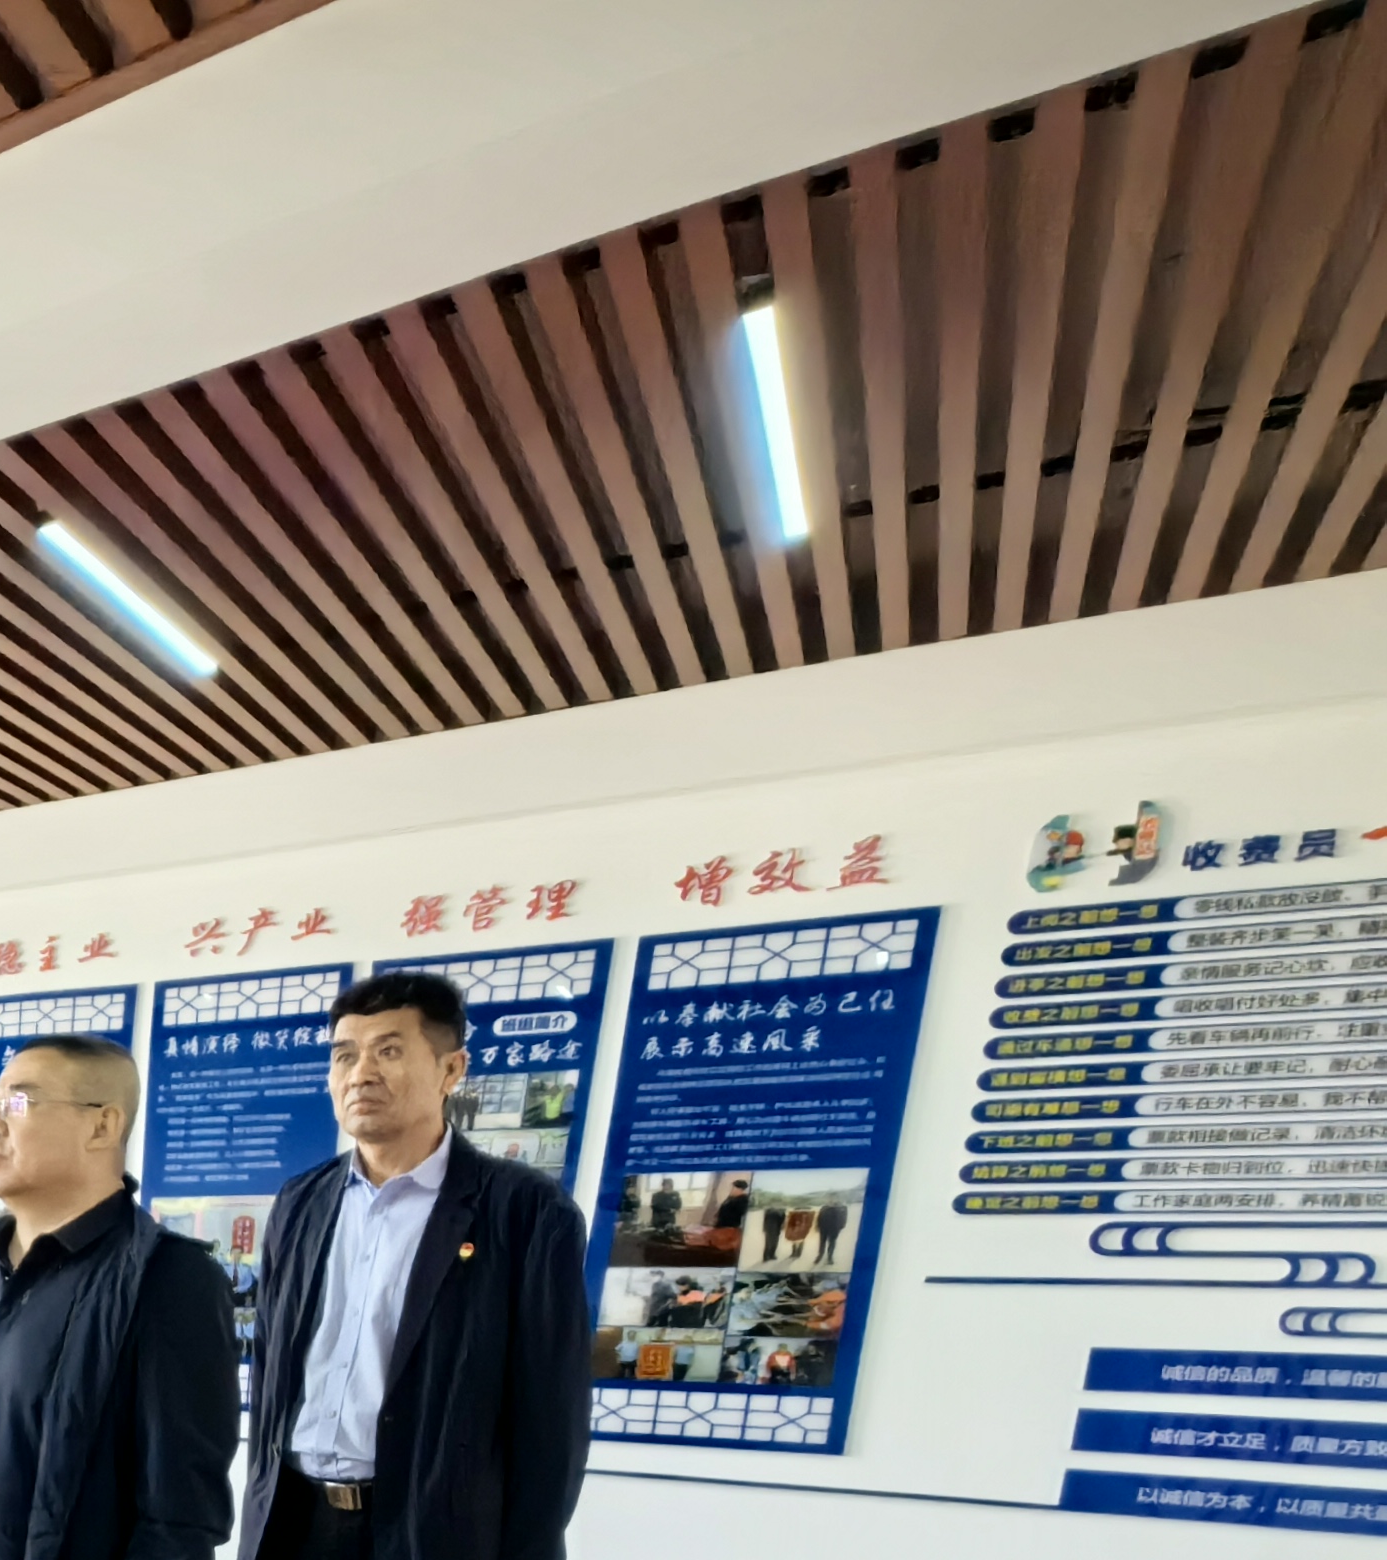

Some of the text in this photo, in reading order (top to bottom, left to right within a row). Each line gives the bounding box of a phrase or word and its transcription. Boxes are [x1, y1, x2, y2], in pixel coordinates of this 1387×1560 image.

[675, 835, 888, 906] 增效益
[184, 907, 335, 958] 兴产业
[401, 880, 577, 938] 强管理
